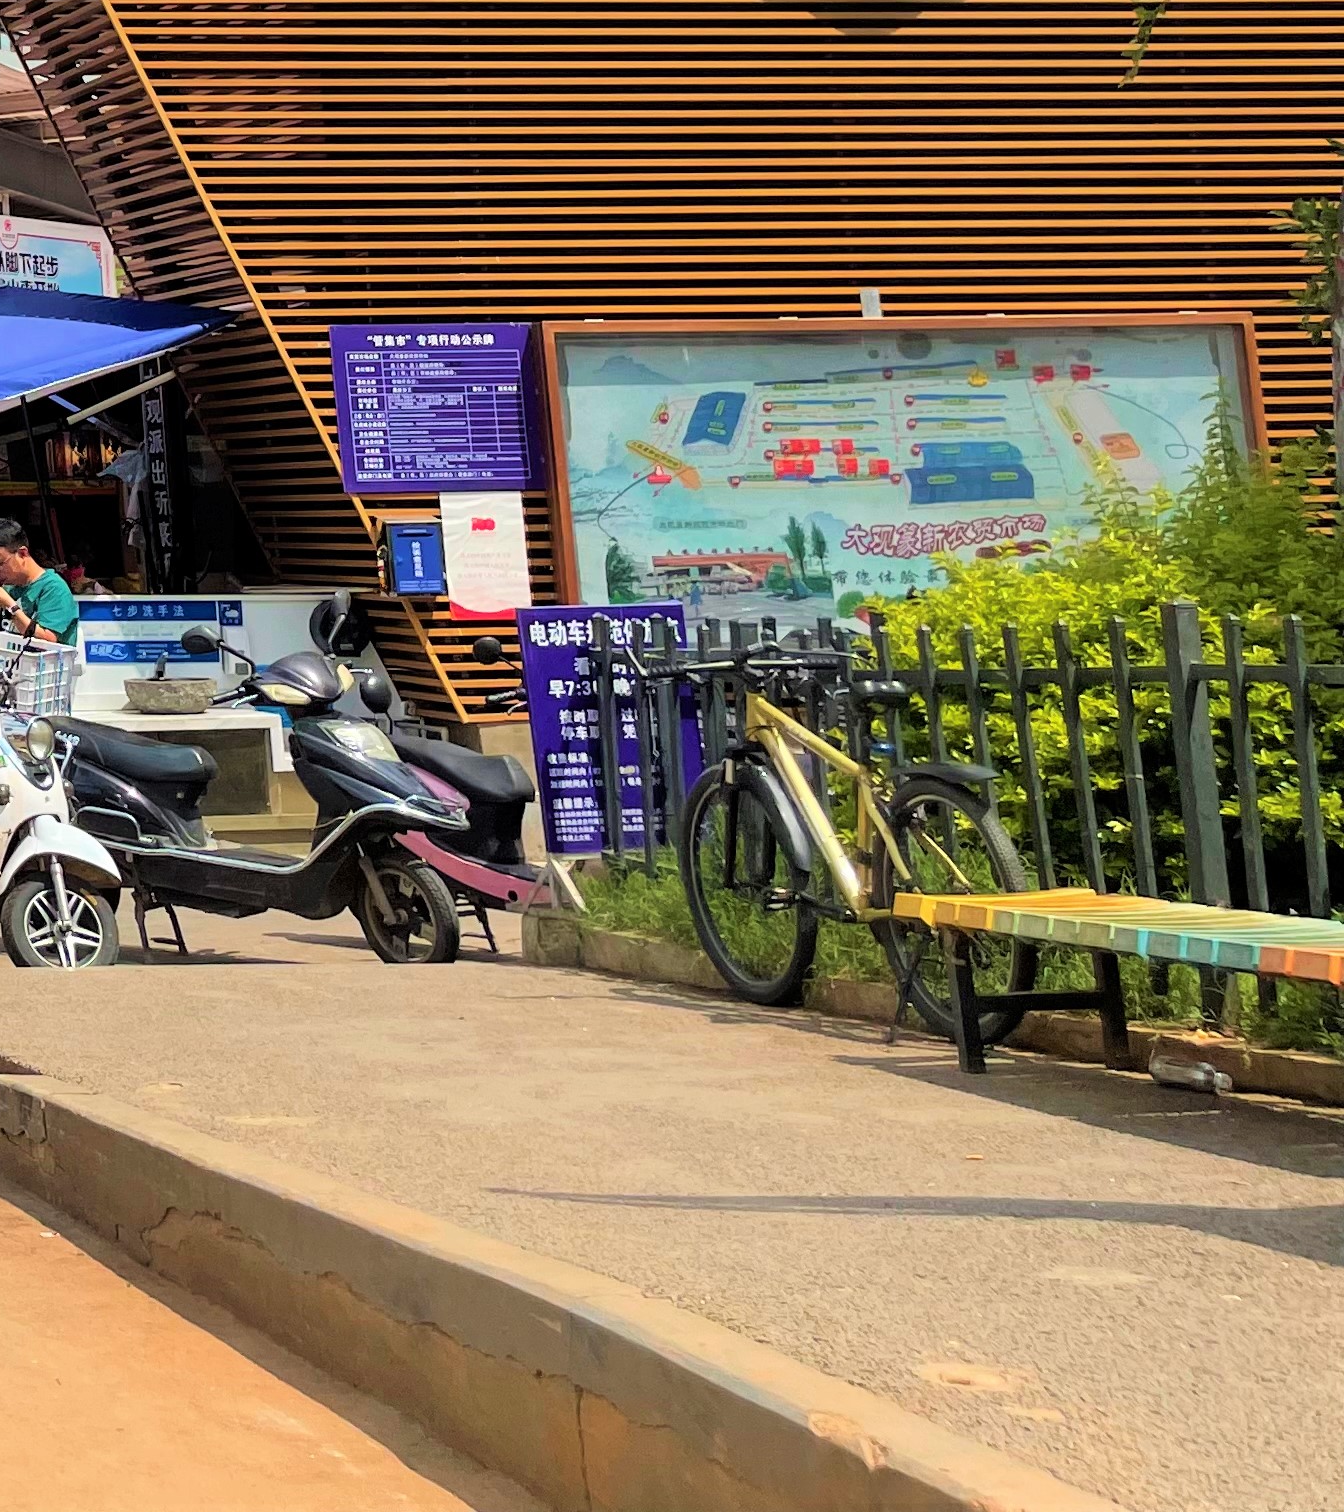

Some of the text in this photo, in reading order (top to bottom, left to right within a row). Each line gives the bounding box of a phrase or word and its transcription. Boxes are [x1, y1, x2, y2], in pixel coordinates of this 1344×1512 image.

[842, 514, 1046, 558] 大观篆新农贸市场
[112, 604, 185, 617] 七步洗手法
